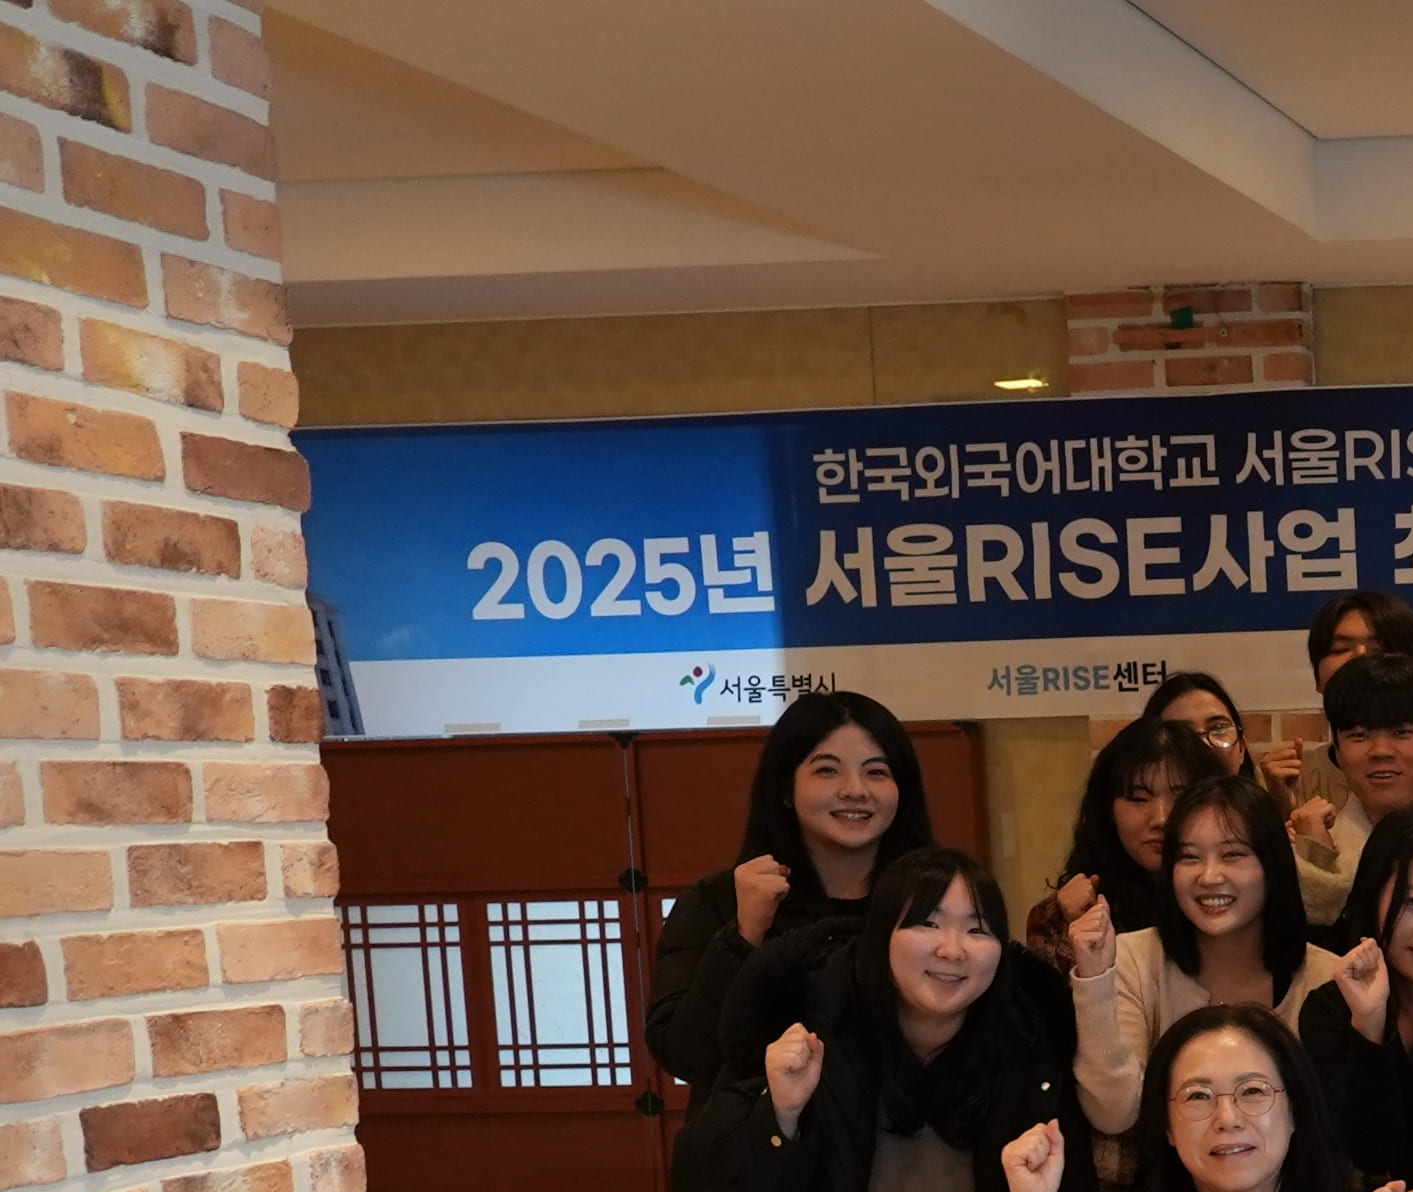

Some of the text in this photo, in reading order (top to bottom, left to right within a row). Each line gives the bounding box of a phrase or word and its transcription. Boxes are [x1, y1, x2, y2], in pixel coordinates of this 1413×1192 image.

[813, 434, 1220, 503] 한국외국어대학교
[467, 531, 775, 620] 2025년
[806, 508, 1358, 607] 서울RISE사업
[988, 660, 1169, 696] 서울RISE센터
